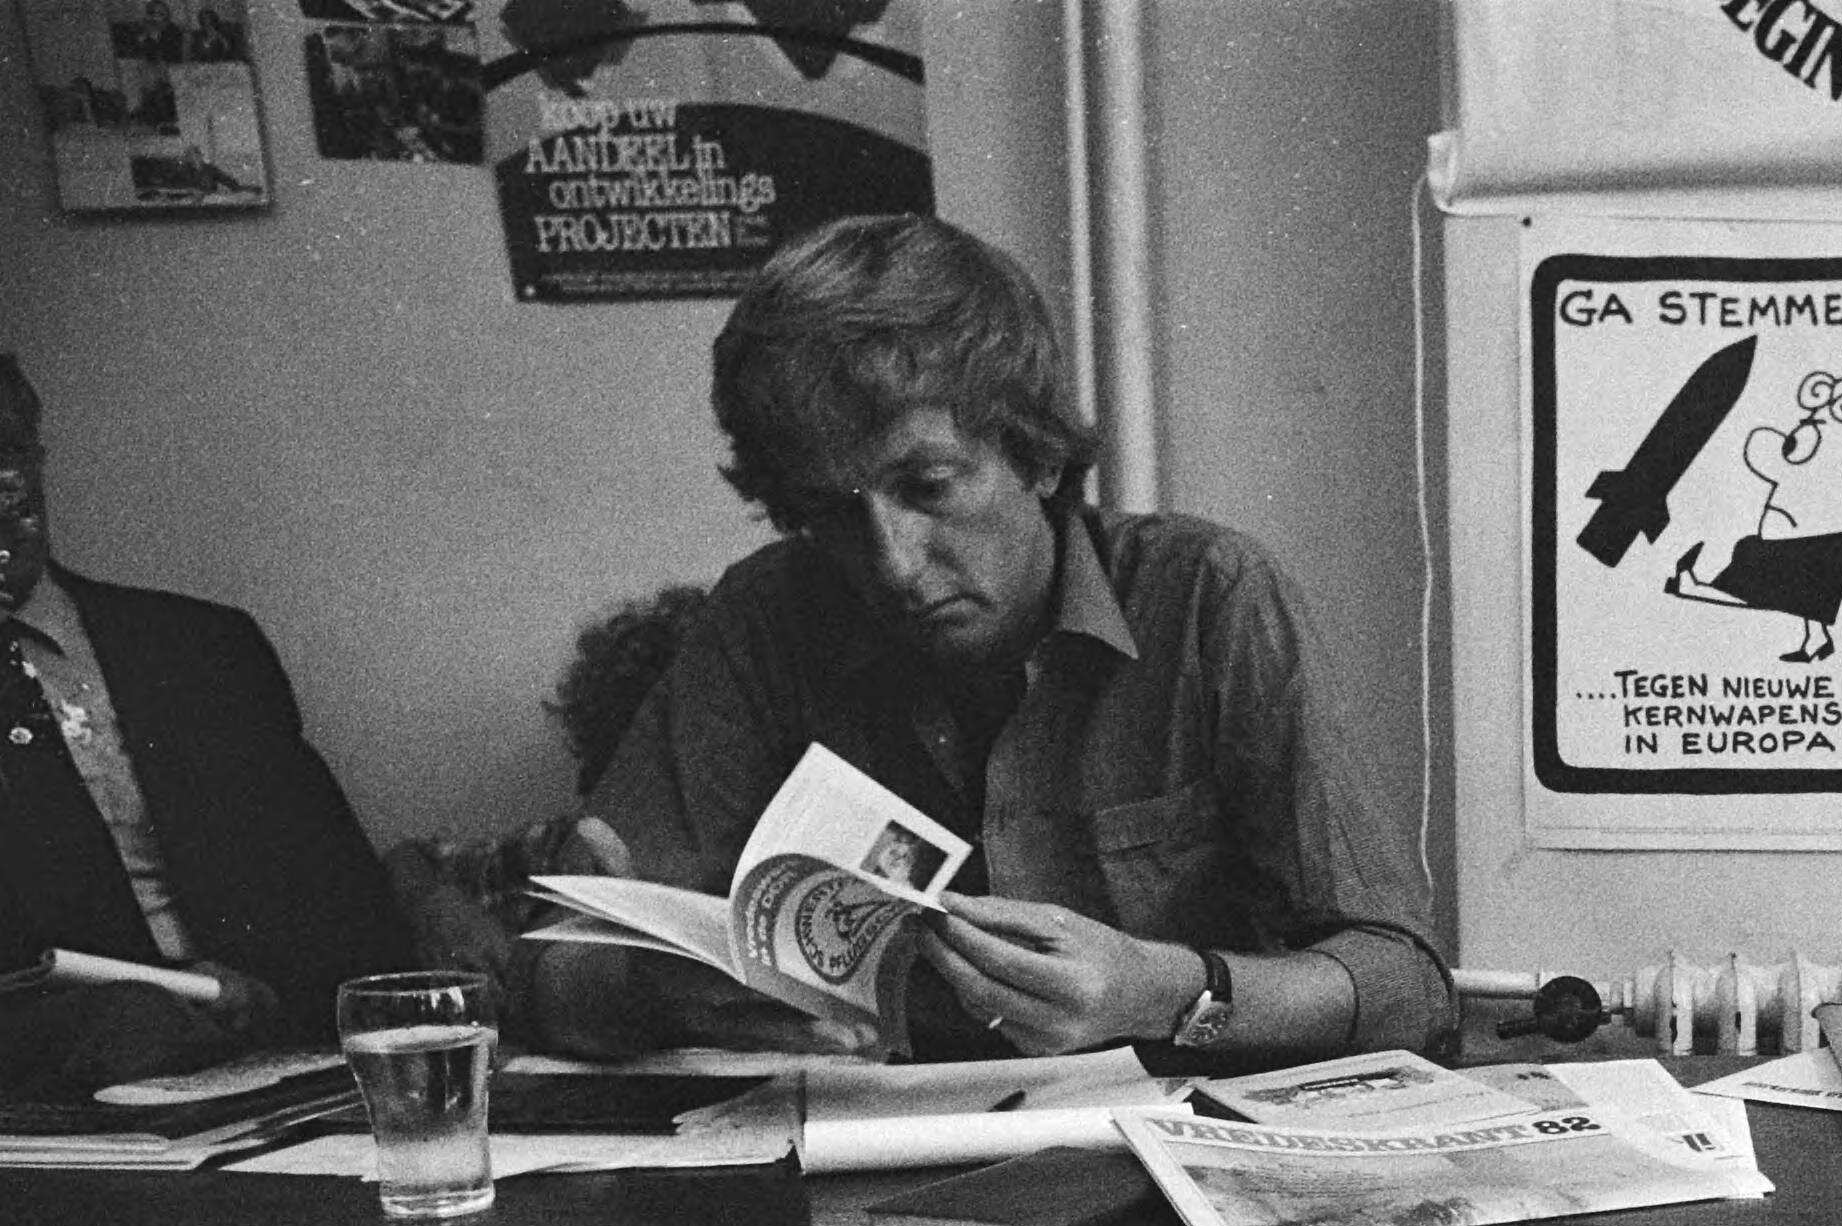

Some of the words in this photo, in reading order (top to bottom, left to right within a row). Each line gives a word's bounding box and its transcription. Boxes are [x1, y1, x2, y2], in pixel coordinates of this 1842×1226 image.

[525, 135, 689, 174] AANDEEL
[692, 135, 726, 171] in
[549, 167, 777, 213] ontwikkelings
[535, 211, 733, 252] PROJECTEN
[1558, 289, 1632, 328] GA
[1723, 675, 1835, 699] NIEUWE
[1624, 701, 1842, 727] KERNWAPENS
[1625, 733, 1657, 754] IN
[1532, 1116, 1601, 1136] 82
